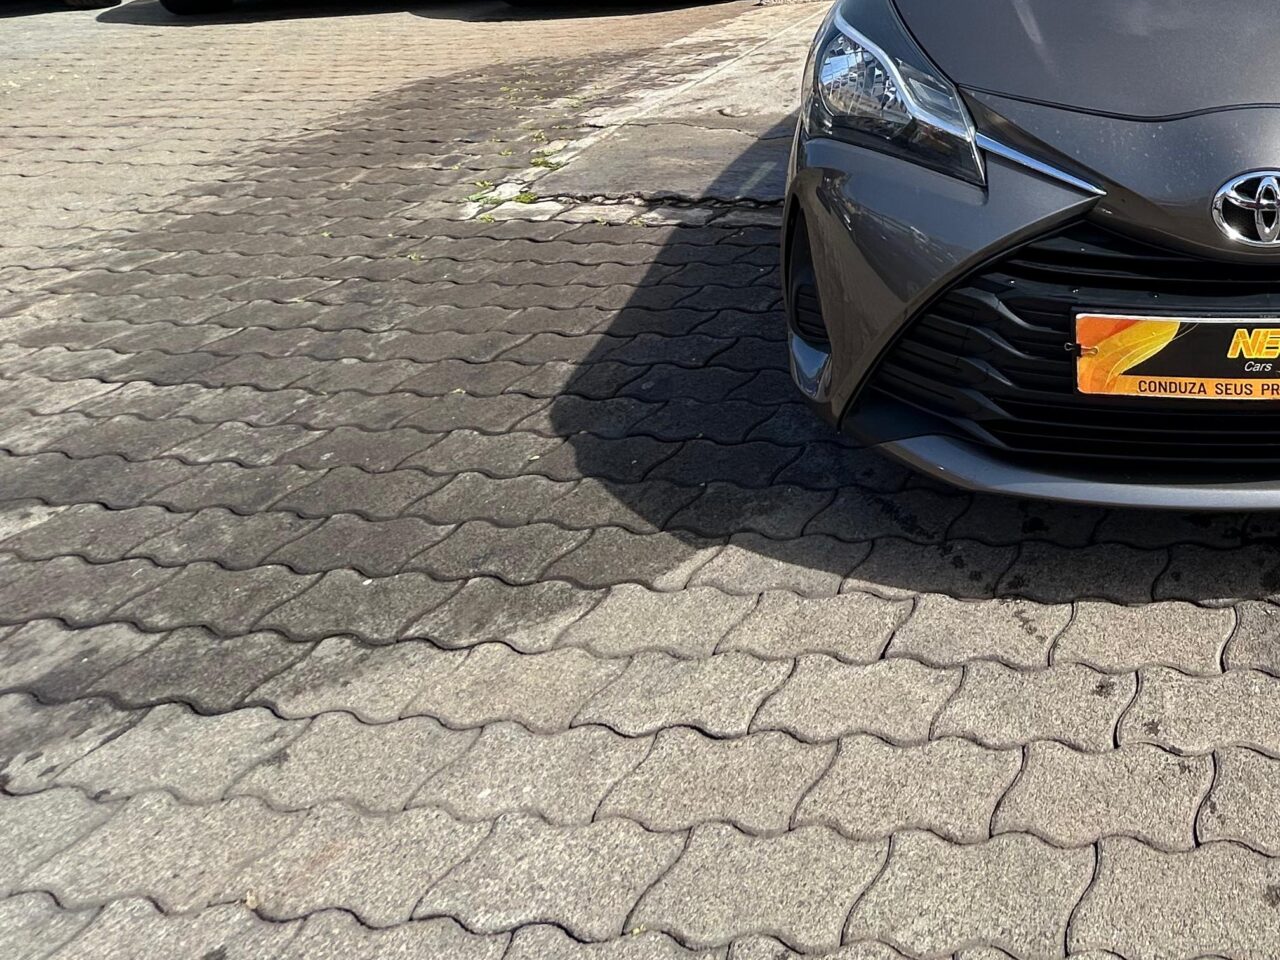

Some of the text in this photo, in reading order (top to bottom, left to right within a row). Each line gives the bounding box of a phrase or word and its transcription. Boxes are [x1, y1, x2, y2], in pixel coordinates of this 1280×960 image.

[1244, 361, 1273, 372] Cars
[1138, 380, 1207, 395] CONDUZA
[1214, 383, 1253, 395] SEUS
